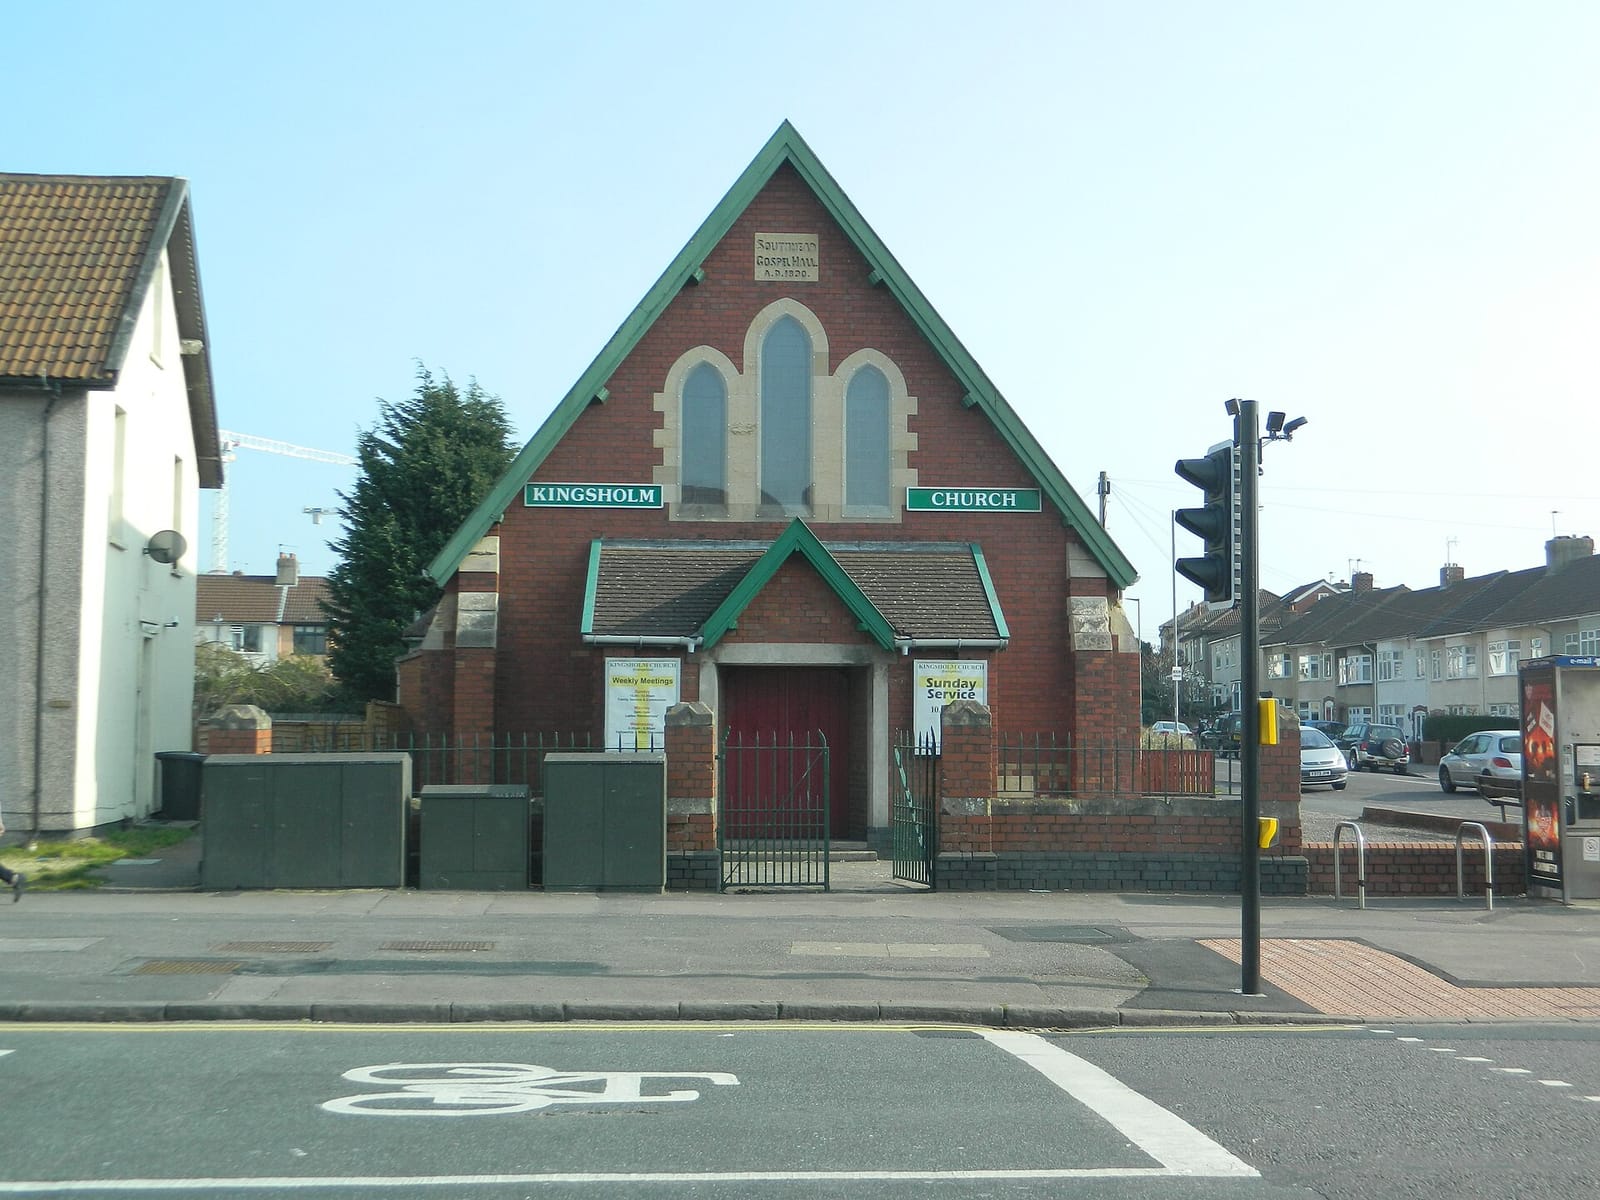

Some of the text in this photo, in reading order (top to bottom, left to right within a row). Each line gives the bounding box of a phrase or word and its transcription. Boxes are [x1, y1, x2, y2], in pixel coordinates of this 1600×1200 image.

[532, 487, 656, 503] KINGSHOLM
[931, 491, 1017, 507] CHURCH
[612, 677, 674, 685] Weekly Meetings
[926, 677, 977, 691] Sunday
[927, 689, 976, 700] Service
